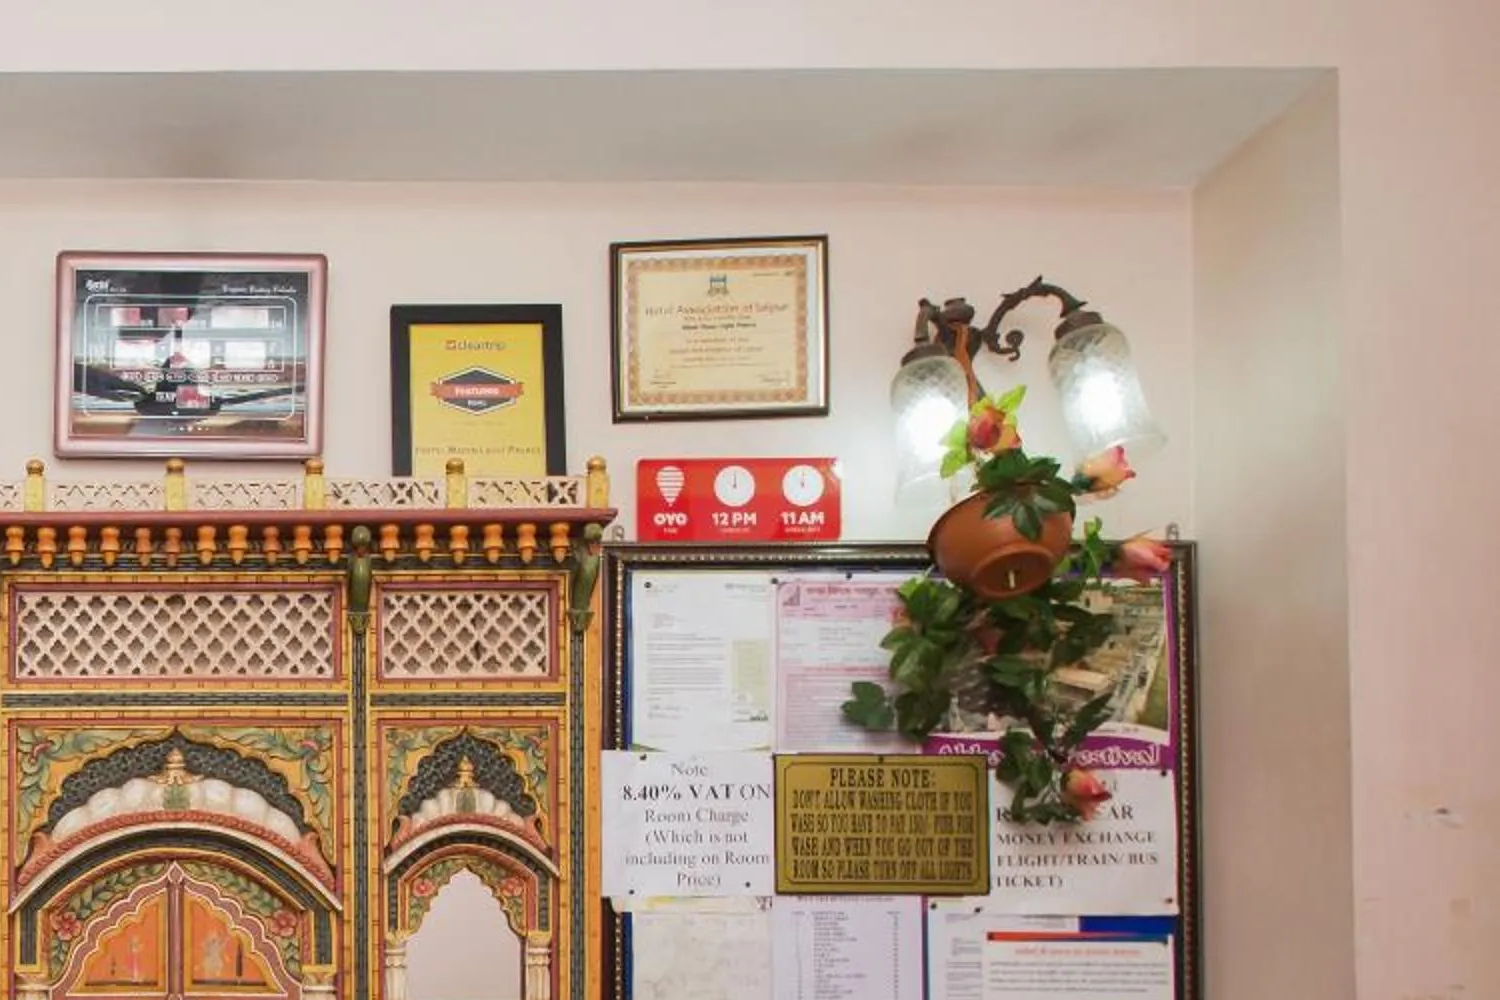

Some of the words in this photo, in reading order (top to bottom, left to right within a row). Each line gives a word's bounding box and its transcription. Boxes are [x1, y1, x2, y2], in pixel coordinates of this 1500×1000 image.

[652, 512, 688, 527] OYO
[711, 512, 731, 527] 12
[731, 512, 758, 526] PM
[779, 511, 795, 525] 11
[795, 511, 826, 525] AM
[1066, 744, 1161, 767] estival
[829, 767, 885, 788] PLEASE
[891, 768, 937, 789] NOTE:
[622, 783, 682, 801] 8.40%
[688, 783, 736, 801] VAT
[739, 783, 771, 801] ON
[823, 790, 855, 811] ALLOW
[644, 808, 691, 823] Room
[695, 808, 749, 826] Charge
[830, 813, 849, 833] YOU
[708, 829, 722, 844] is
[724, 830, 749, 844] not
[996, 832, 1057, 846] MONEY
[1063, 831, 1157, 845] EXCHANGE
[791, 836, 819, 857] WASH
[822, 836, 841, 857] AND
[843, 837, 871, 857] WHEN
[875, 837, 895, 857] YOU
[898, 837, 912, 857] GO
[915, 838, 934, 857] OUT
[954, 838, 974, 858] THE
[625, 851, 697, 868] including
[700, 854, 720, 866] on
[724, 851, 770, 865] Room
[1128, 852, 1159, 866] BUS
[792, 859, 819, 880] ROOM
[821, 859, 835, 880] SO
[836, 860, 870, 881] PLEASE
